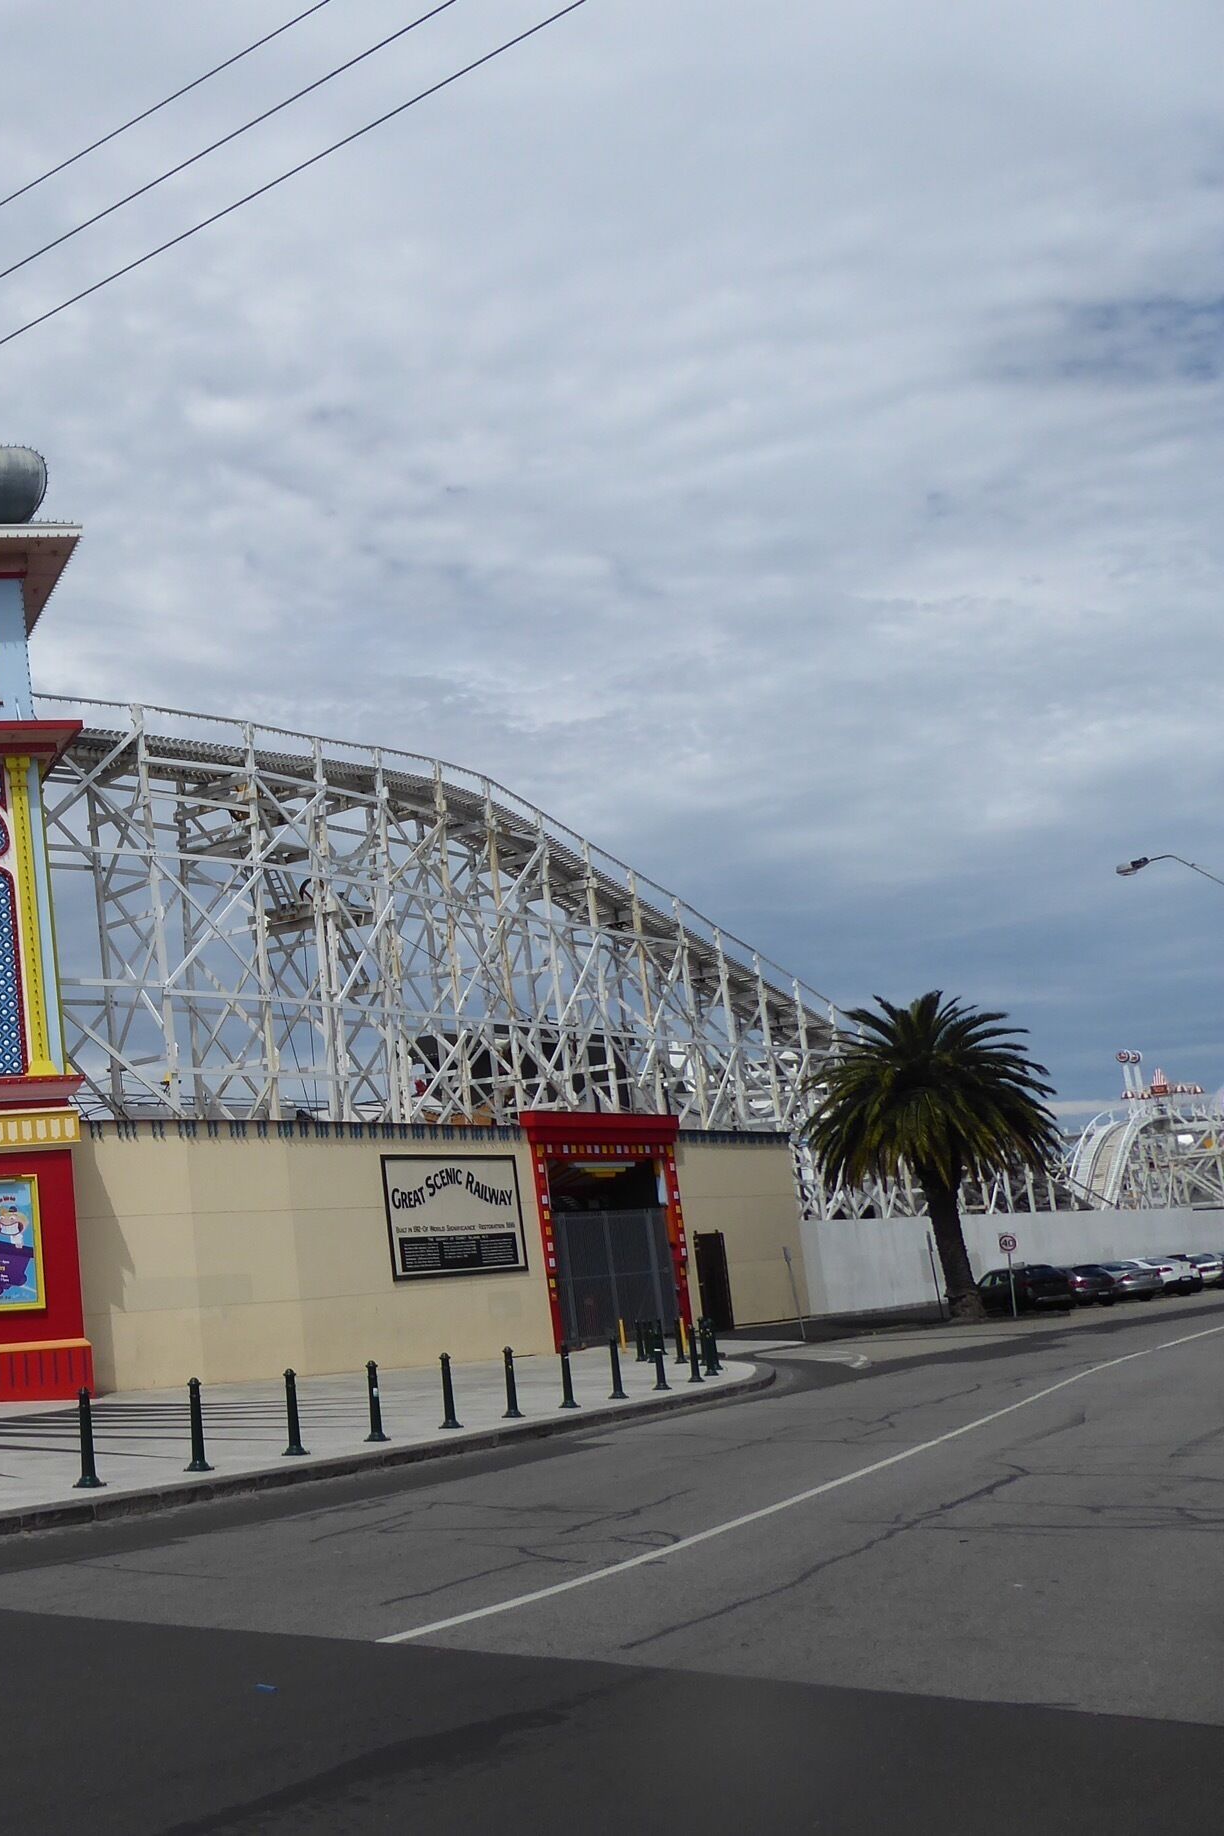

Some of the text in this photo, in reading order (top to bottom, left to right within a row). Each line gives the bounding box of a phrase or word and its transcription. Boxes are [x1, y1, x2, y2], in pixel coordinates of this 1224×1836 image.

[391, 1168, 513, 1209] GREAT SCENIC RAILWAY
[1002, 1239, 1015, 1247] 40
